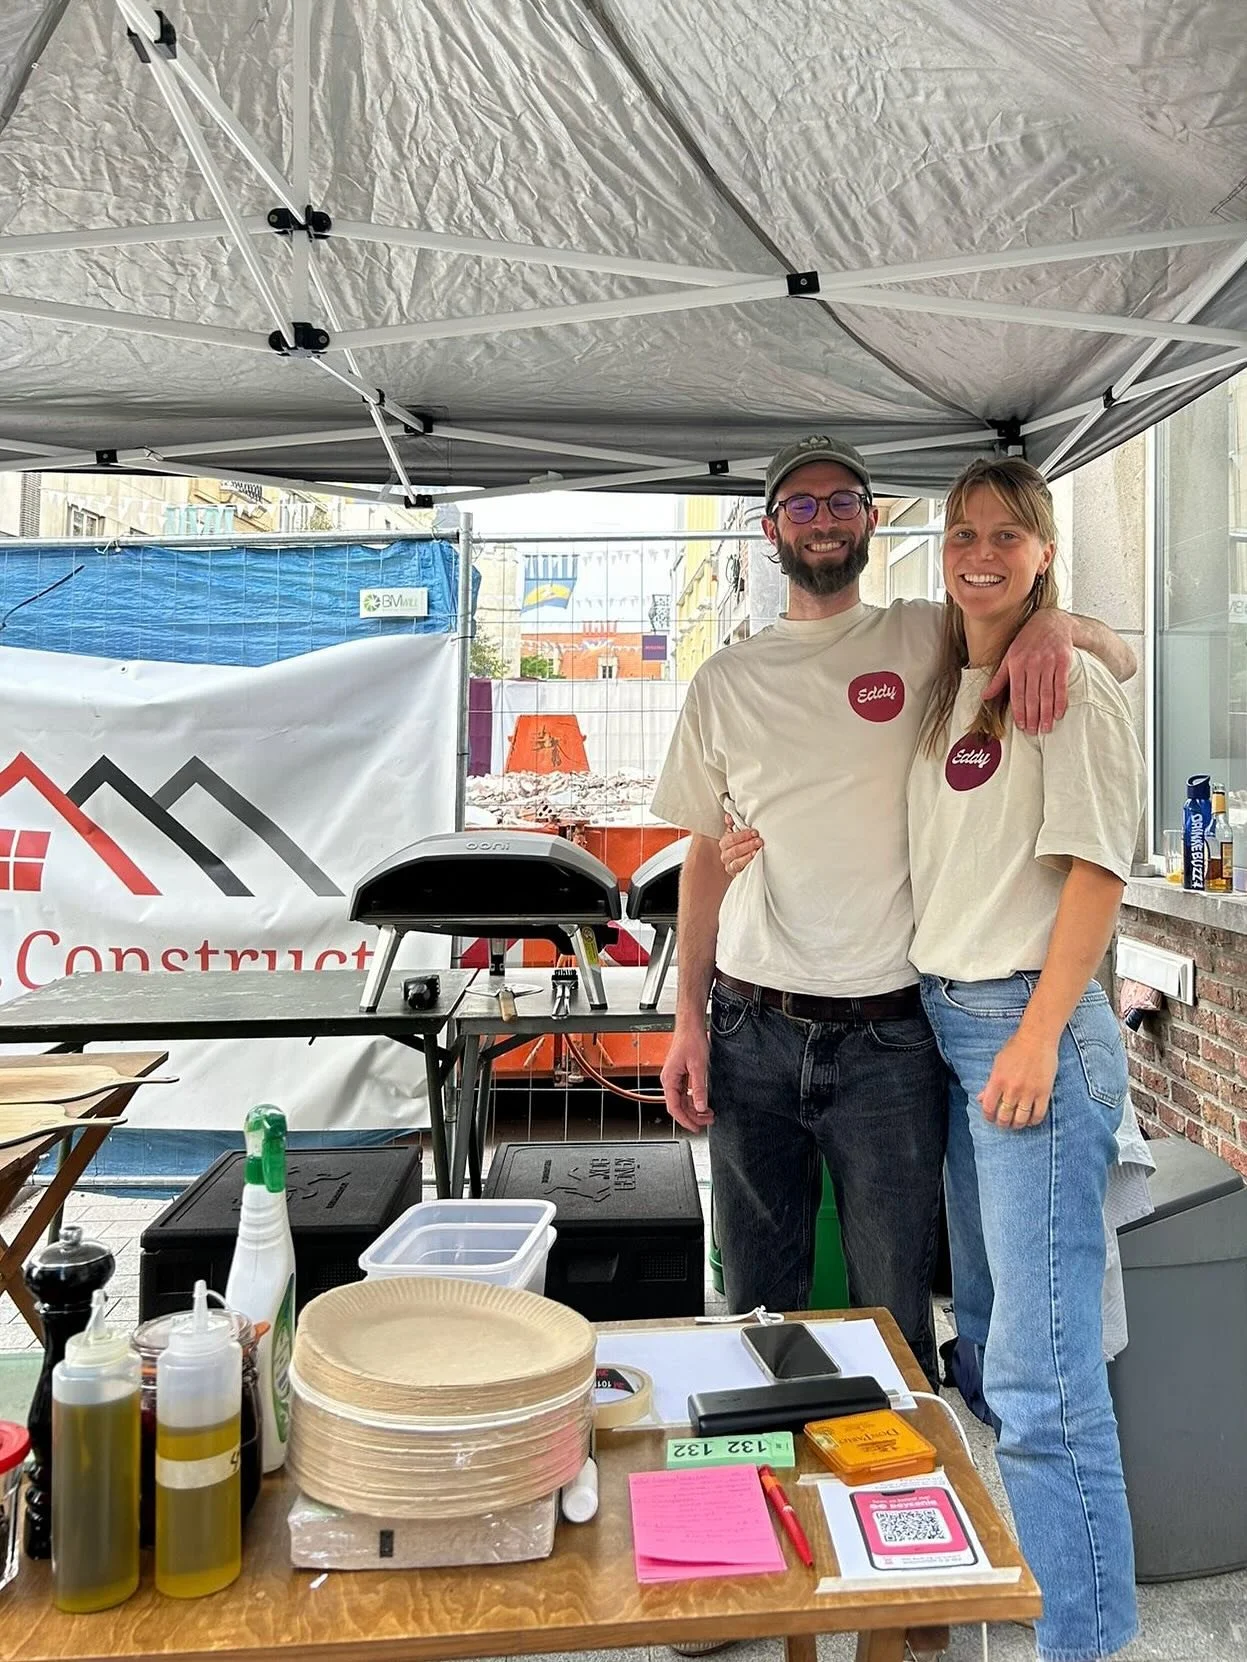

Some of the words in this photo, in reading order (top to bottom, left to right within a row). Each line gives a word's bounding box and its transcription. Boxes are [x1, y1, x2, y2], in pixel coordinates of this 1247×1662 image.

[857, 683, 897, 704] Eddy
[951, 748, 991, 769] Eddy
[466, 841, 510, 851] ooni
[16, 929, 375, 990] Construct
[673, 1443, 712, 1458] 132
[726, 1440, 767, 1454] 132
